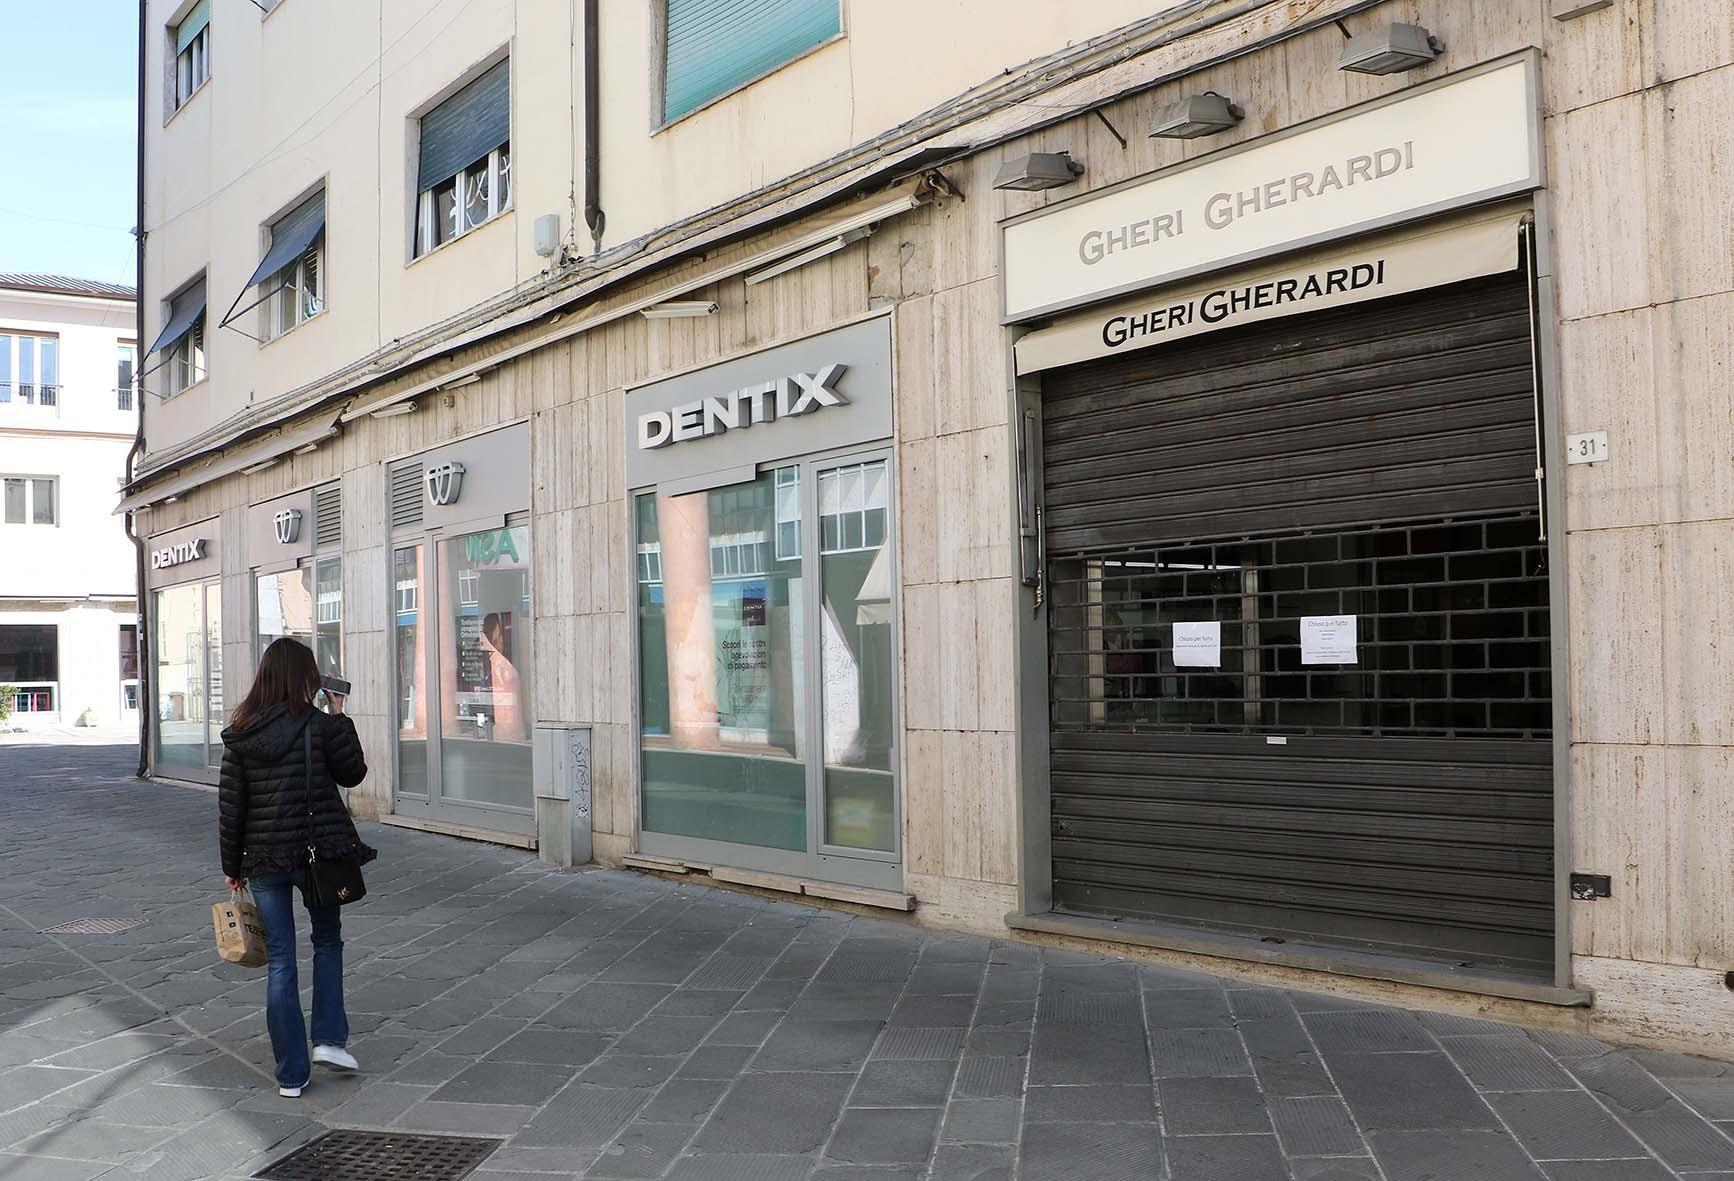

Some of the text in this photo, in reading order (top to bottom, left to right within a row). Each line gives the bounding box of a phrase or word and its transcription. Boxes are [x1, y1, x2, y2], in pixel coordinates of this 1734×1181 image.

[1079, 140, 1414, 266] GHERI GHERARDI
[1102, 259, 1385, 348] GHERI GHERARDI
[638, 363, 849, 449] DENTIX
[1580, 438, 1595, 456] 31
[151, 538, 206, 570] DENTIX
